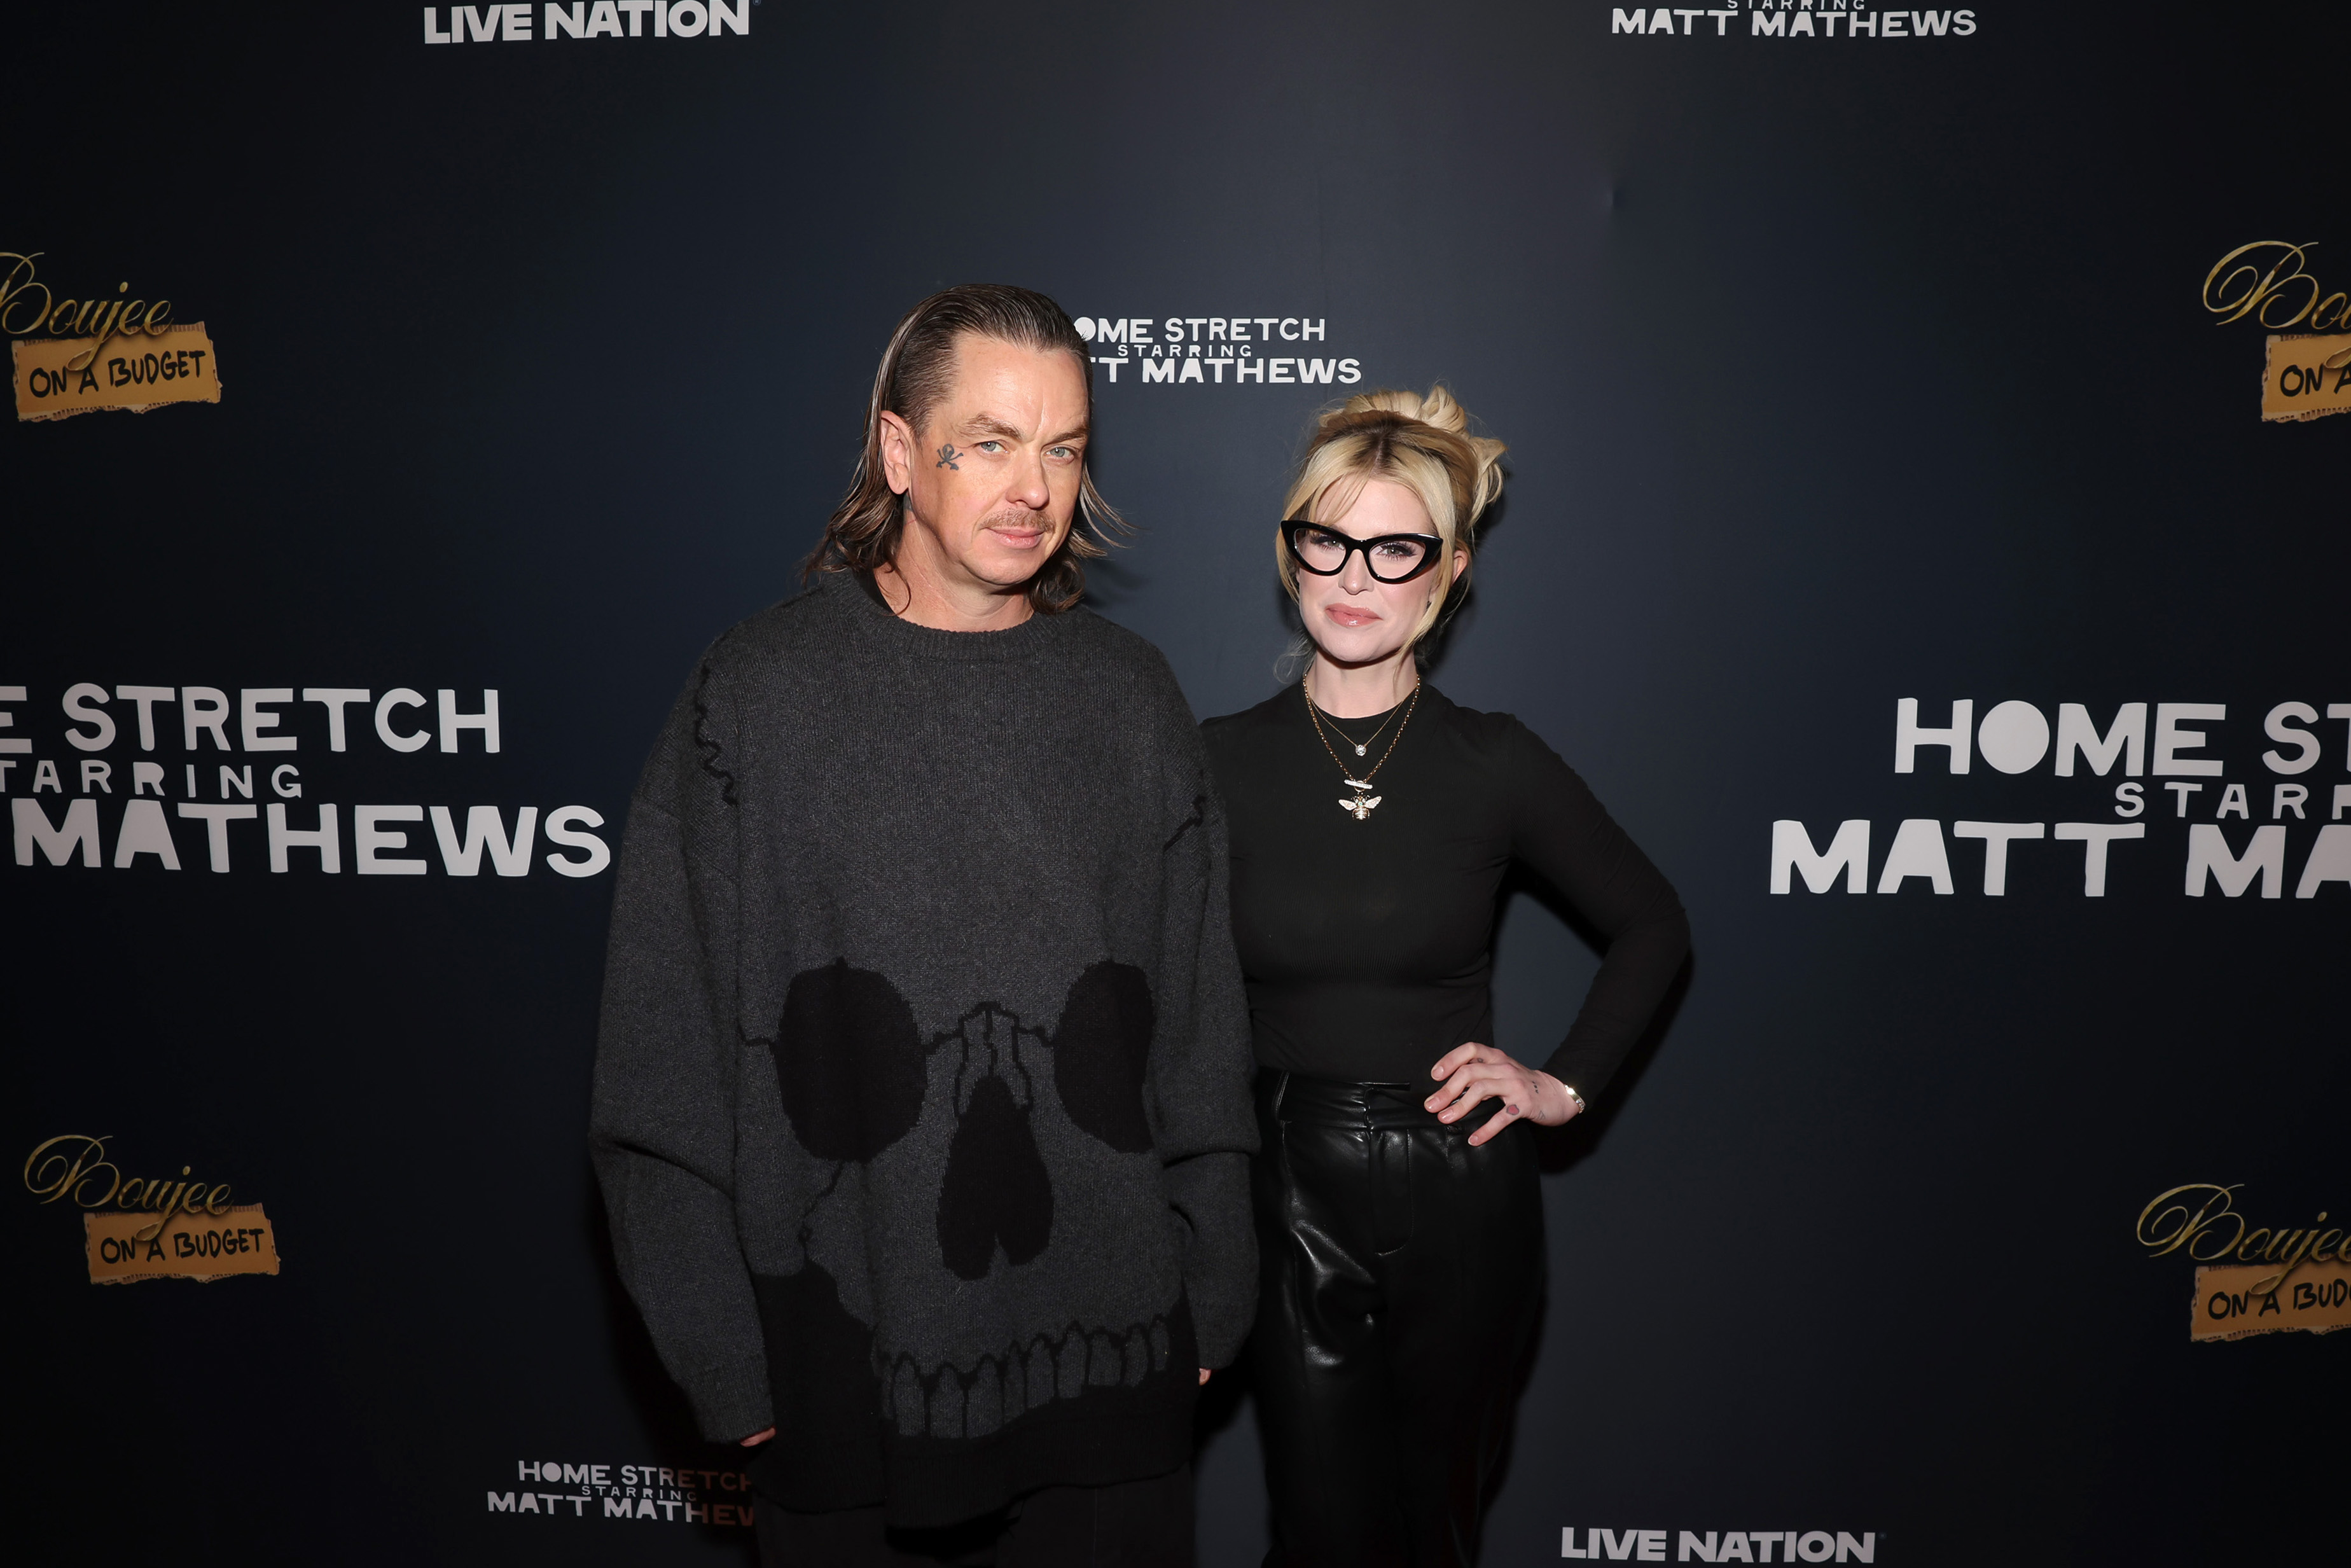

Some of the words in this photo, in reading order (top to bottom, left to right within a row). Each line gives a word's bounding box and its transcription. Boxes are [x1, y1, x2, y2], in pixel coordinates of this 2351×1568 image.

[424, 4, 532, 44] LIVE
[544, 0, 749, 39] NATION
[1611, 8, 1738, 36] MATT
[1751, 10, 1976, 37] MATHEWS
[1073, 317, 1153, 343] OME
[1165, 317, 1325, 342] STRETCH
[1118, 344, 1251, 357] STARRING
[29, 366, 67, 398] ON
[78, 367, 99, 394] A
[107, 350, 206, 387] BUDGET
[1142, 357, 1362, 384] MATHEWS
[2280, 363, 2324, 397] ON
[62, 682, 500, 753] STRETCH
[1895, 698, 2226, 777] HOME
[11, 798, 611, 878] MATHEWS
[1770, 819, 2146, 897] MATT
[24, 1134, 233, 1241] Boujee
[101, 1236, 136, 1264] ON
[146, 1238, 165, 1262] A
[173, 1228, 264, 1258] BUDGET
[2208, 1290, 2250, 1320] ON
[2258, 1291, 2280, 1317] A
[518, 1460, 611, 1485] HOME
[487, 1491, 592, 1516] MATT
[581, 1485, 697, 1502] STARRING
[1561, 1527, 1667, 1561] LIVE
[1677, 1530, 1875, 1563] NATION
